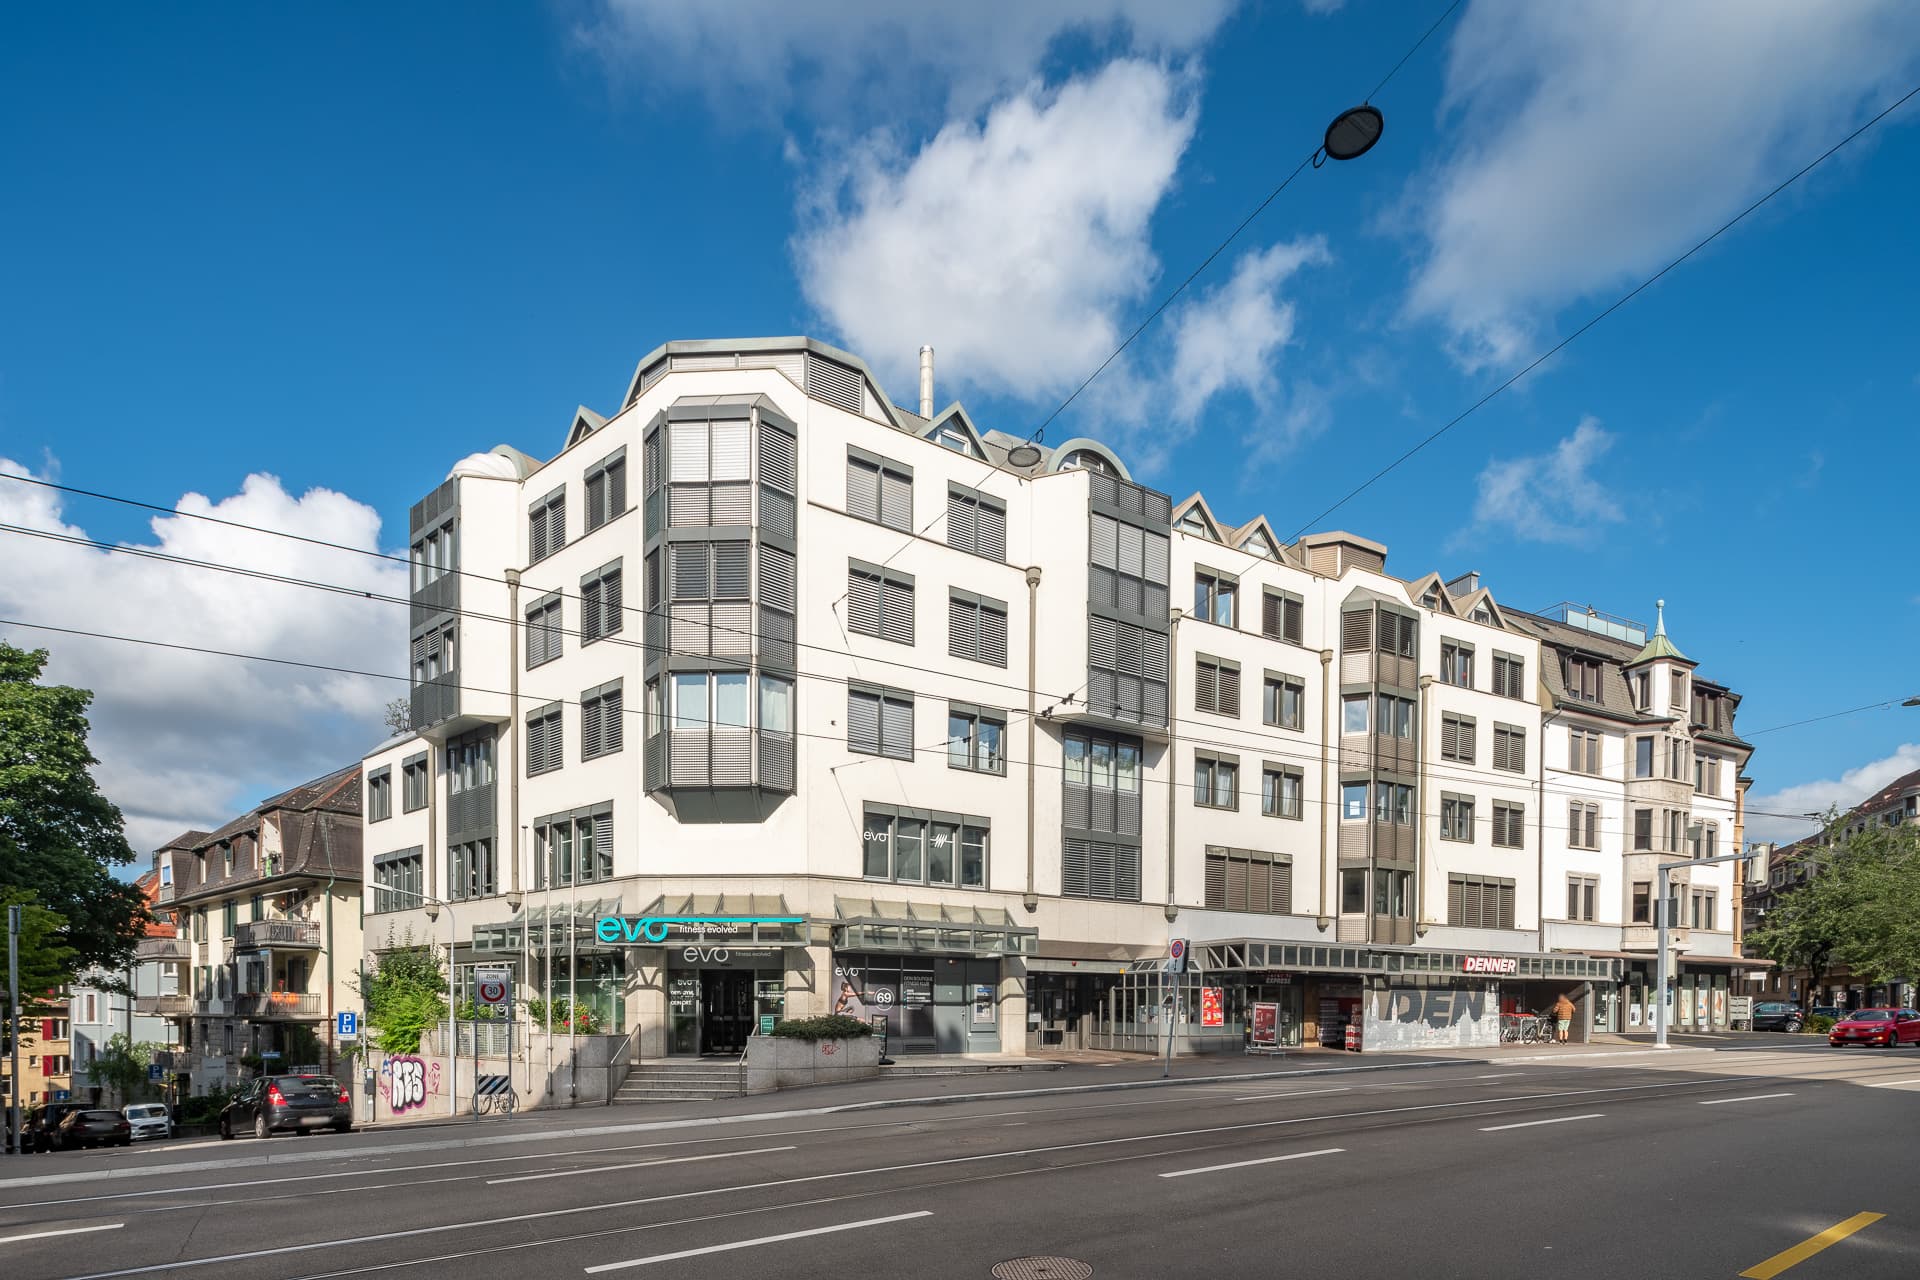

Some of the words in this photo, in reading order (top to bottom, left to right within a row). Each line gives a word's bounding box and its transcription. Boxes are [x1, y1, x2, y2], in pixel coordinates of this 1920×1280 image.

[863, 830, 888, 843] evo
[597, 916, 668, 942] evo
[679, 924, 705, 934] fitness
[707, 924, 738, 934] evolved
[683, 947, 729, 962] evo
[1465, 956, 1517, 973] DENNER
[835, 967, 859, 977] evo
[487, 986, 499, 996] 30
[876, 992, 892, 1004] 69
[343, 1013, 351, 1025] P
